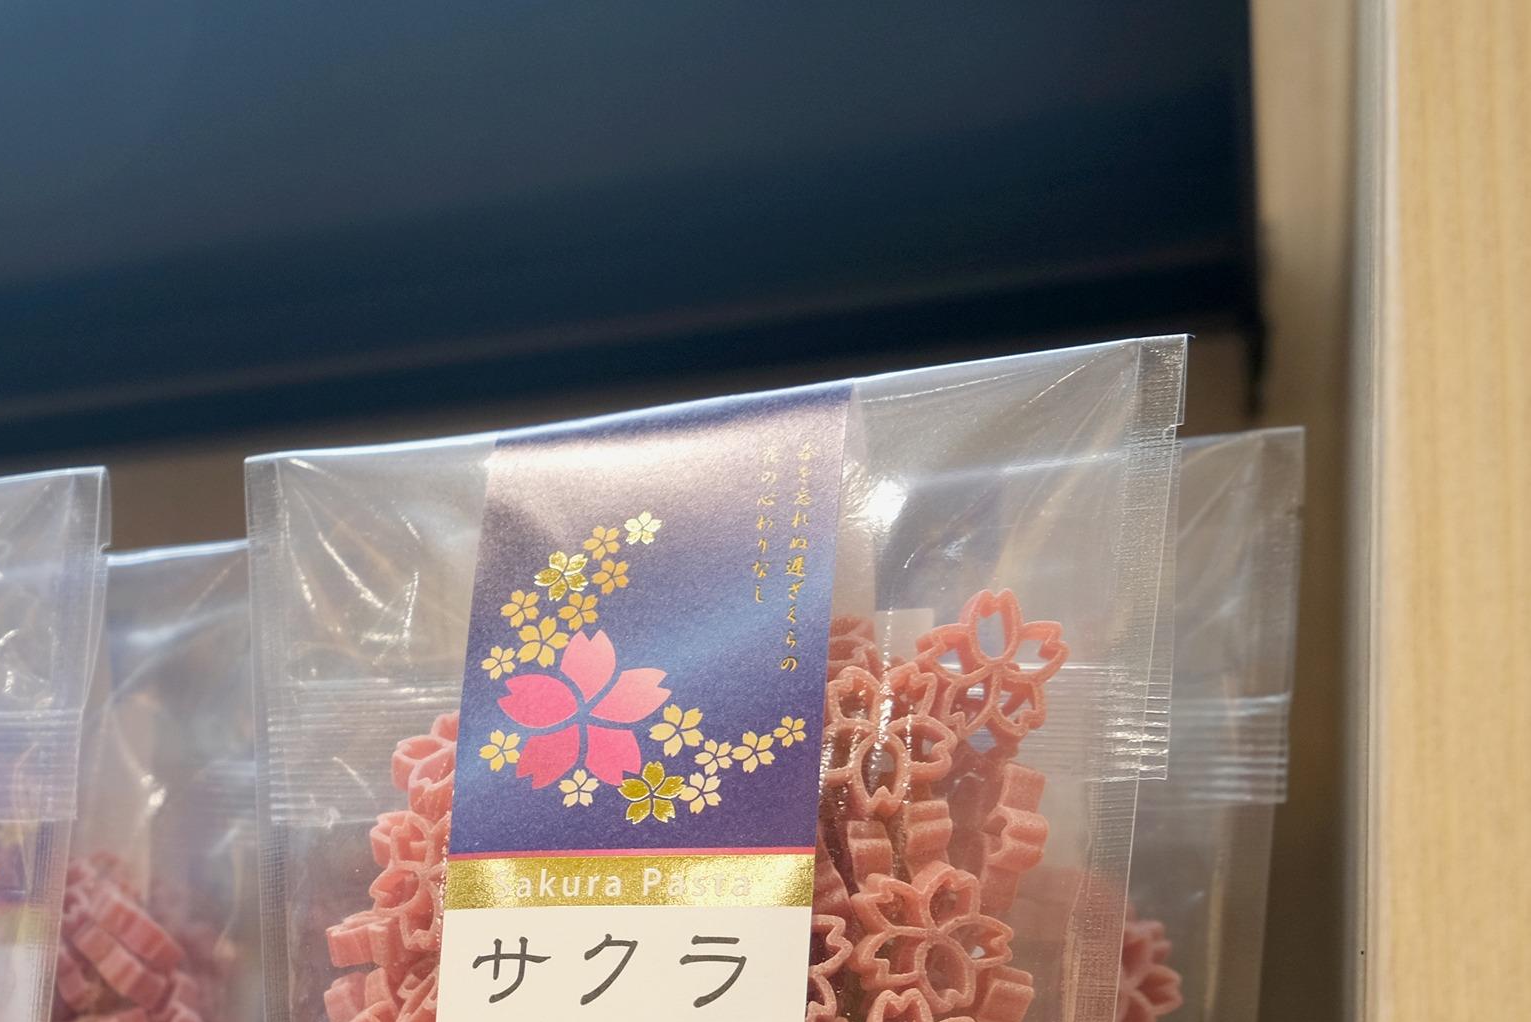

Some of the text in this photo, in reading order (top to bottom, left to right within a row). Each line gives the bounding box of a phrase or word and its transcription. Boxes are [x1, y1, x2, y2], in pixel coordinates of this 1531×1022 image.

[494, 866, 754, 900] Sakura Pasta
[471, 932, 748, 1009] サクラ
